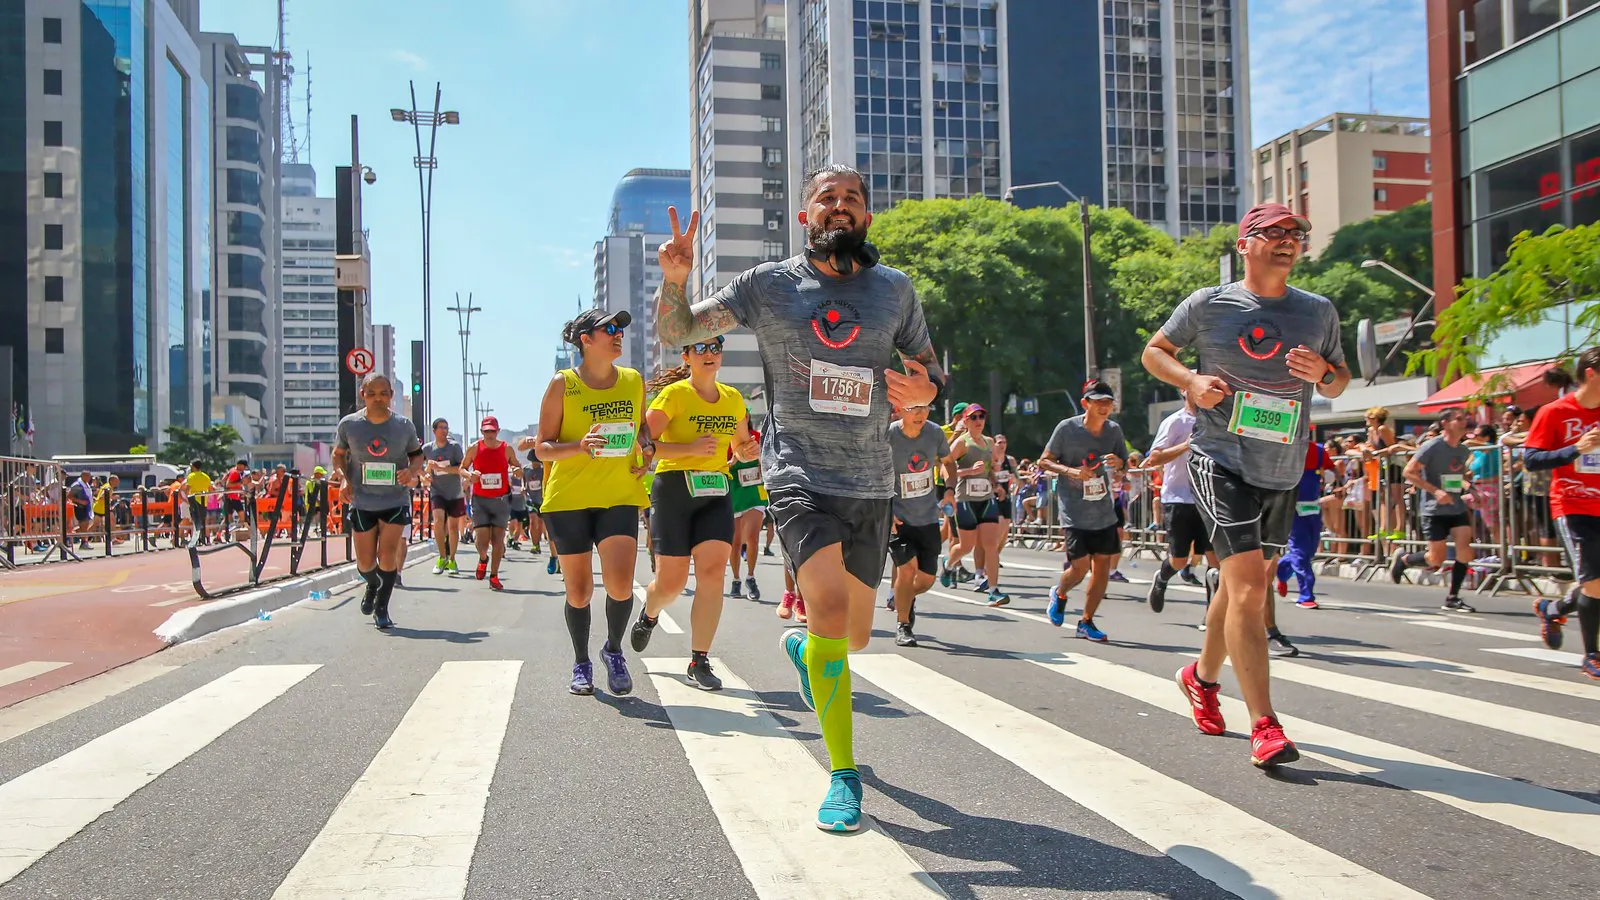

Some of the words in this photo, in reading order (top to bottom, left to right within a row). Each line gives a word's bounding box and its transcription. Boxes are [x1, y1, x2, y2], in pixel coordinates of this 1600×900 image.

[822, 377, 861, 398] 17561
[583, 400, 633, 412] #CONTRA
[590, 407, 633, 419] TEMPO
[1253, 409, 1281, 426] 3599
[606, 434, 626, 445] 1476
